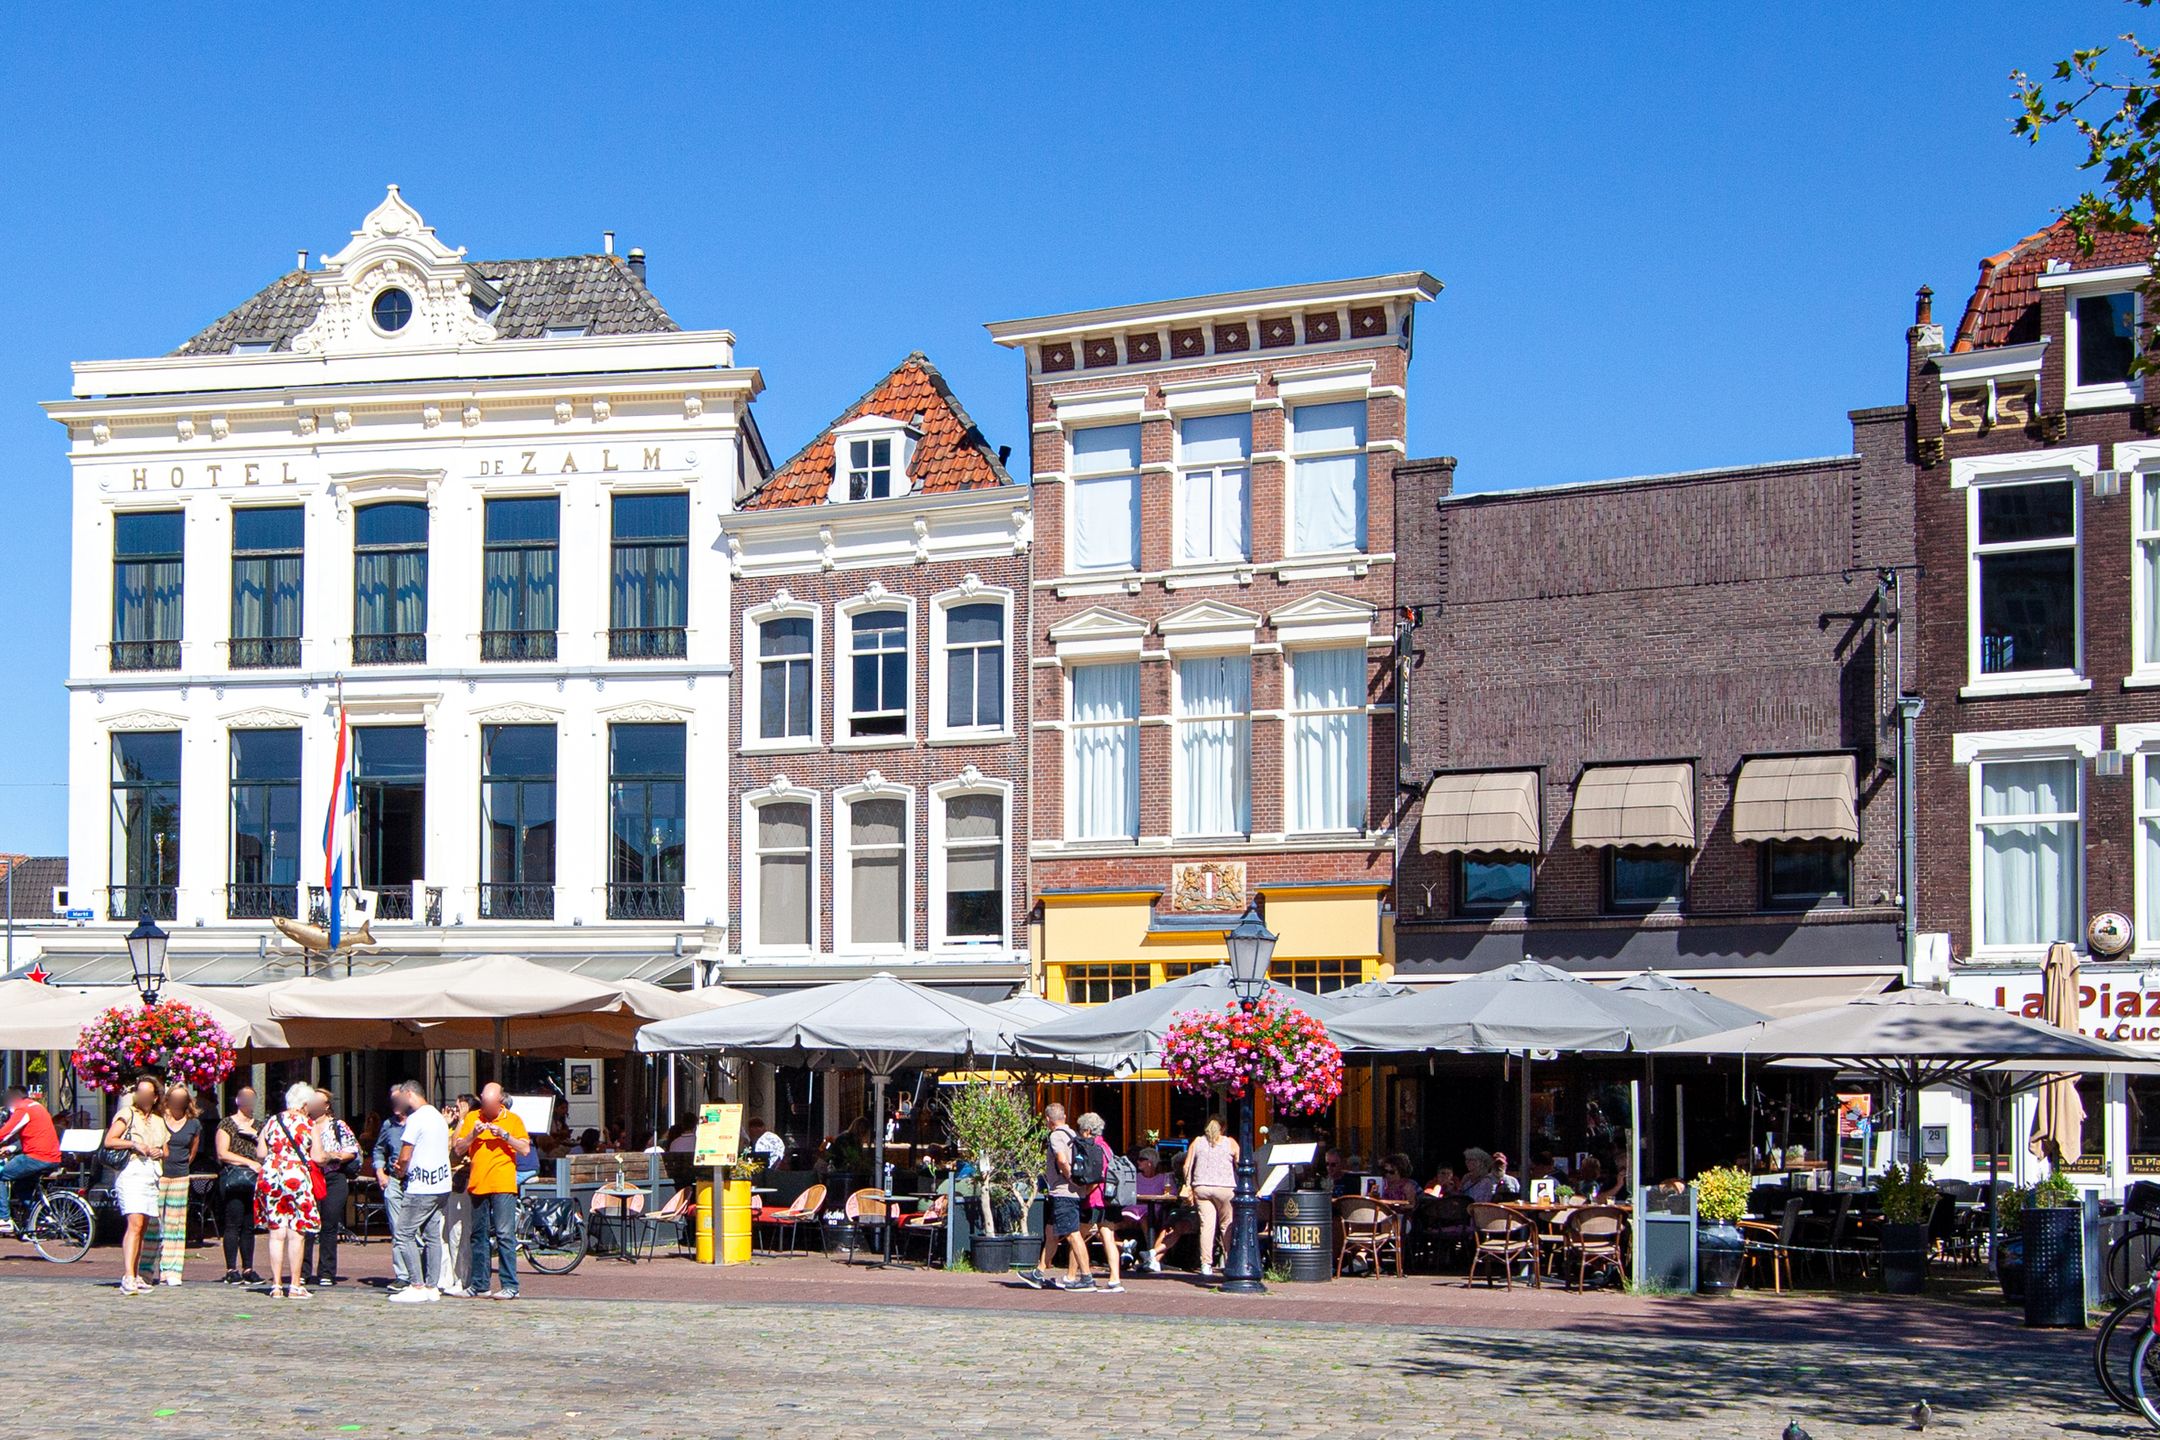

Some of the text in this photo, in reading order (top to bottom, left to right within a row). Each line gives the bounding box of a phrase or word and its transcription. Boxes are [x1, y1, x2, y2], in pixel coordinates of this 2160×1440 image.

[133, 447, 661, 490] HOTEL DE ZALM
[1928, 1130, 1940, 1140] 29
[2131, 1158, 2143, 1166] La
